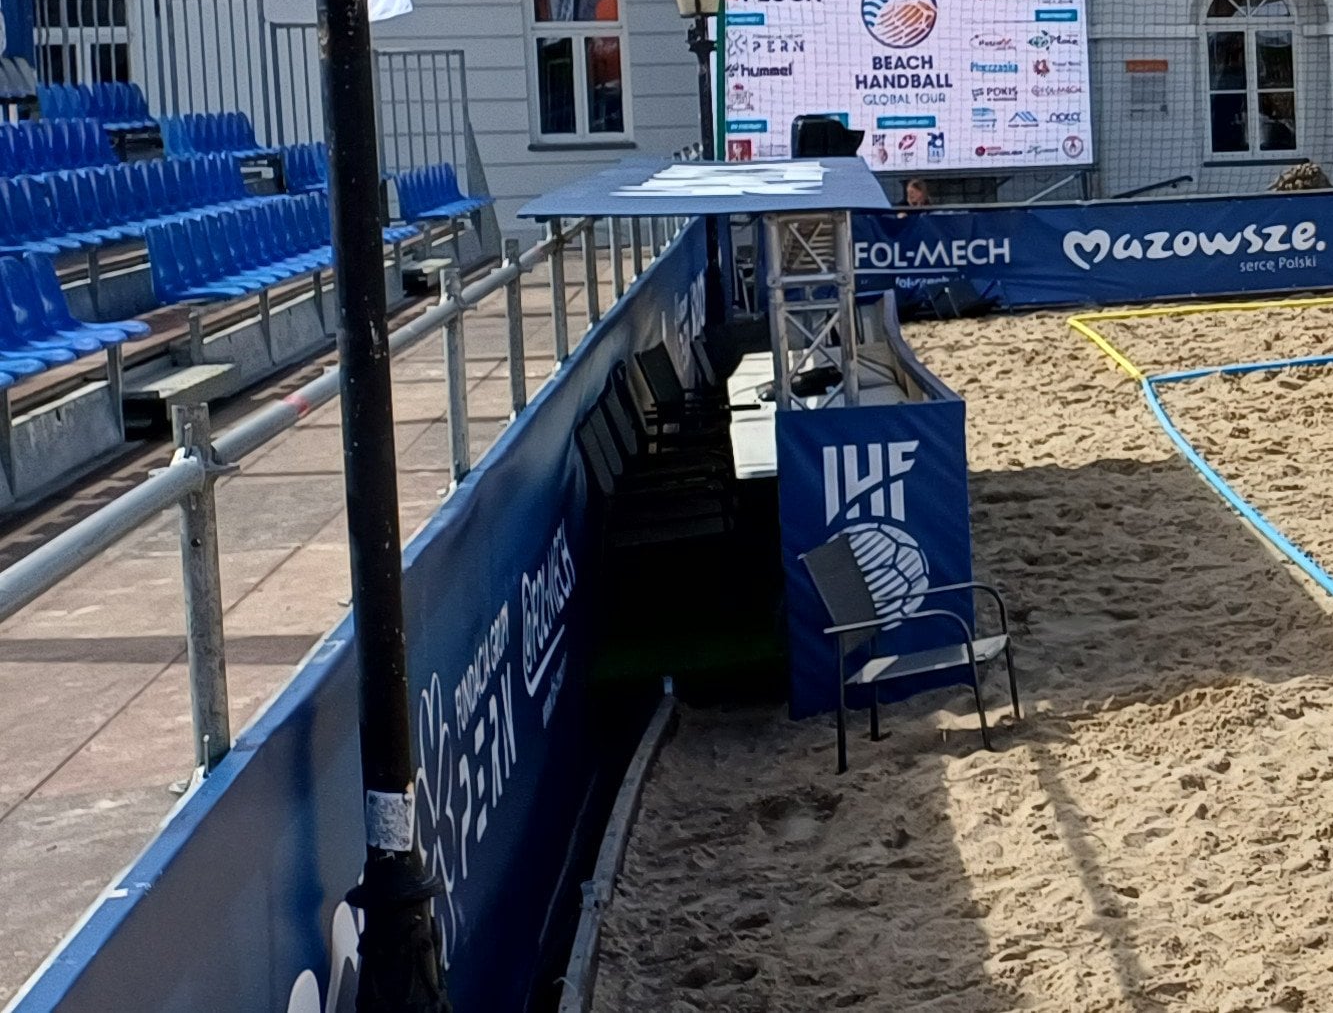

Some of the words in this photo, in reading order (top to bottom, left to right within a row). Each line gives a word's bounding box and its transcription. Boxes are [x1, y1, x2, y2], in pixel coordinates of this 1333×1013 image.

[752, 40, 806, 53] PERN
[740, 60, 795, 78] hummel
[872, 55, 934, 70] BEACH
[855, 73, 953, 90] HANDBALL
[862, 94, 911, 106] GLOBAL
[916, 92, 946, 104] TOUR
[854, 238, 1011, 268] FOL-MECH
[1278, 255, 1317, 270] Polski
[823, 440, 920, 527] IHF
[459, 661, 517, 880] PERN
